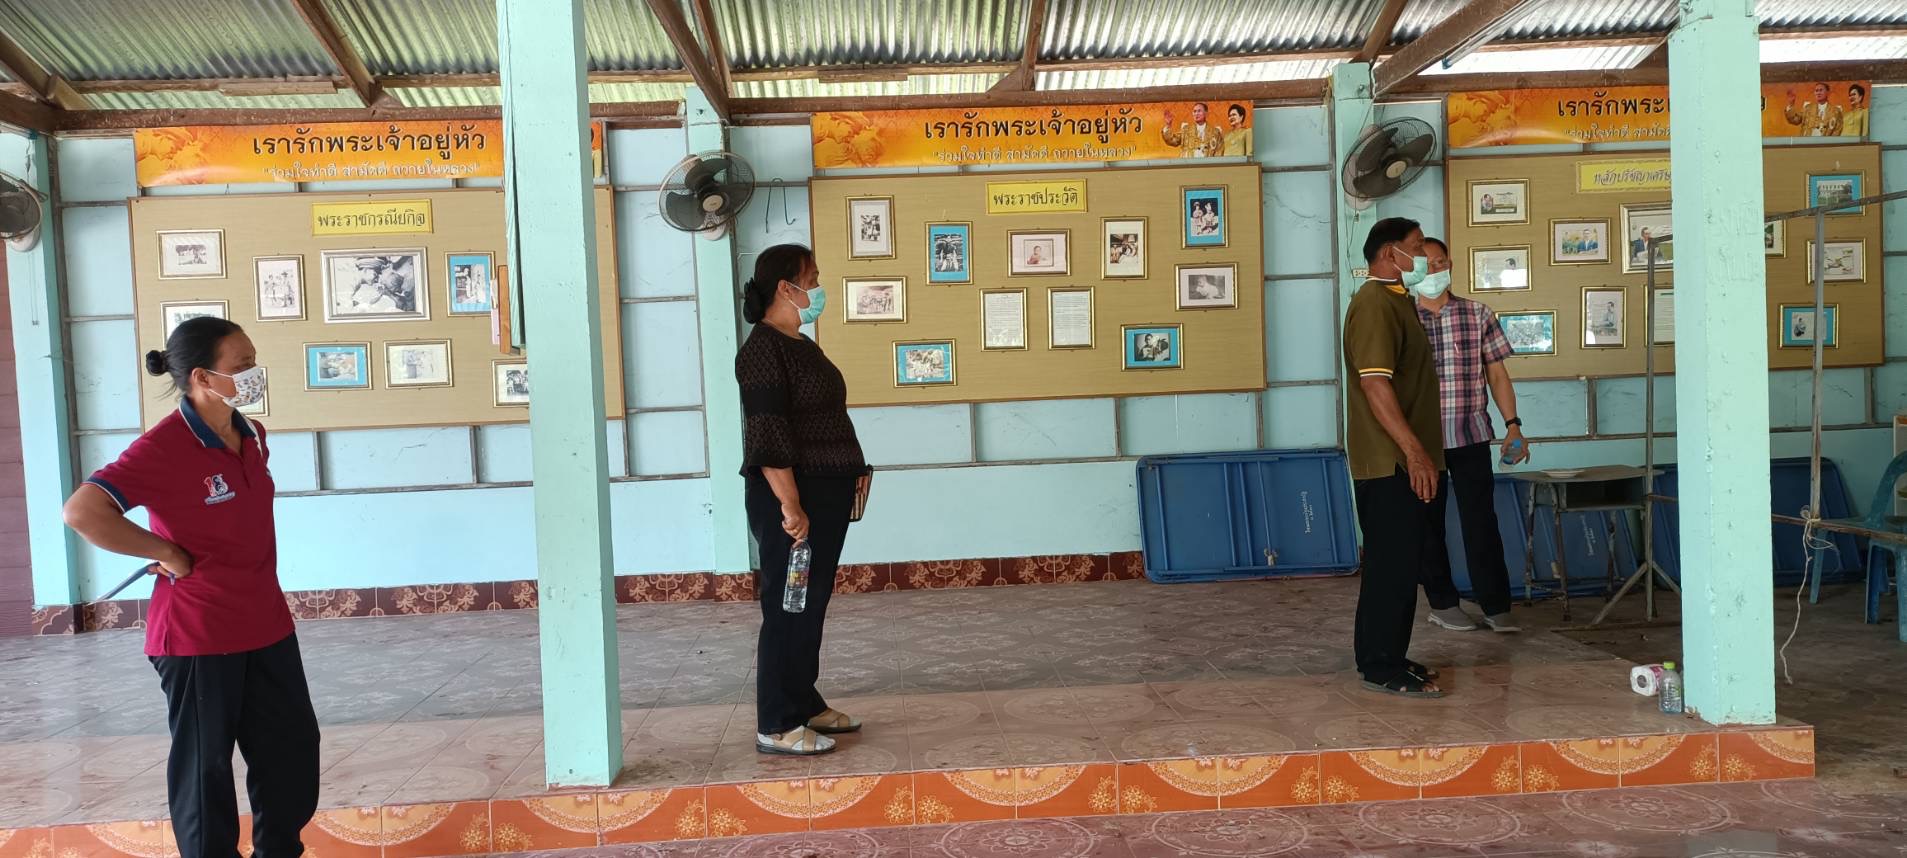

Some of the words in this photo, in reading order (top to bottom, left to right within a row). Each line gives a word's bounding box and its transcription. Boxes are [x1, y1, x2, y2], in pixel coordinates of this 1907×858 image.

[924, 107, 1143, 144] เรารักพระเจ้าอยู่หัว
[253, 124, 485, 160] เรารักพระเจ้าอยู่หัว
[993, 186, 1078, 206] พระราชประวัติ
[317, 208, 426, 228] พระราชกรณียกิจ
